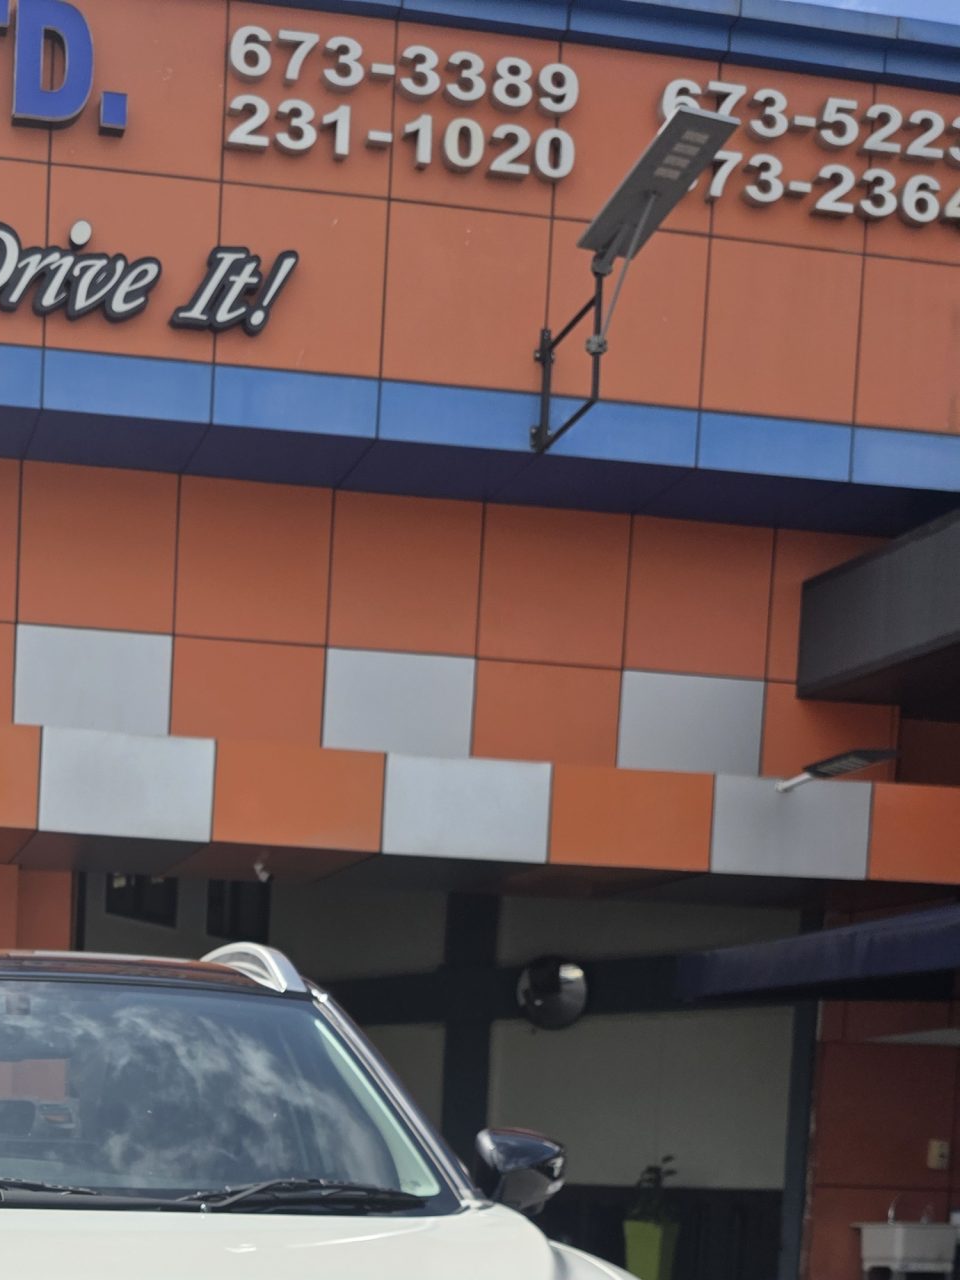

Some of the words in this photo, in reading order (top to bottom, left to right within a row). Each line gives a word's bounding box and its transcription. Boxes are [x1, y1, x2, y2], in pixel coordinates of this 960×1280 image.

[228, 25, 580, 115] 673-3389
[226, 94, 576, 181] 231-1020
[661, 79, 960, 163] 673-522
[688, 150, 960, 224] 73-236
[175, 249, 299, 330] It!
